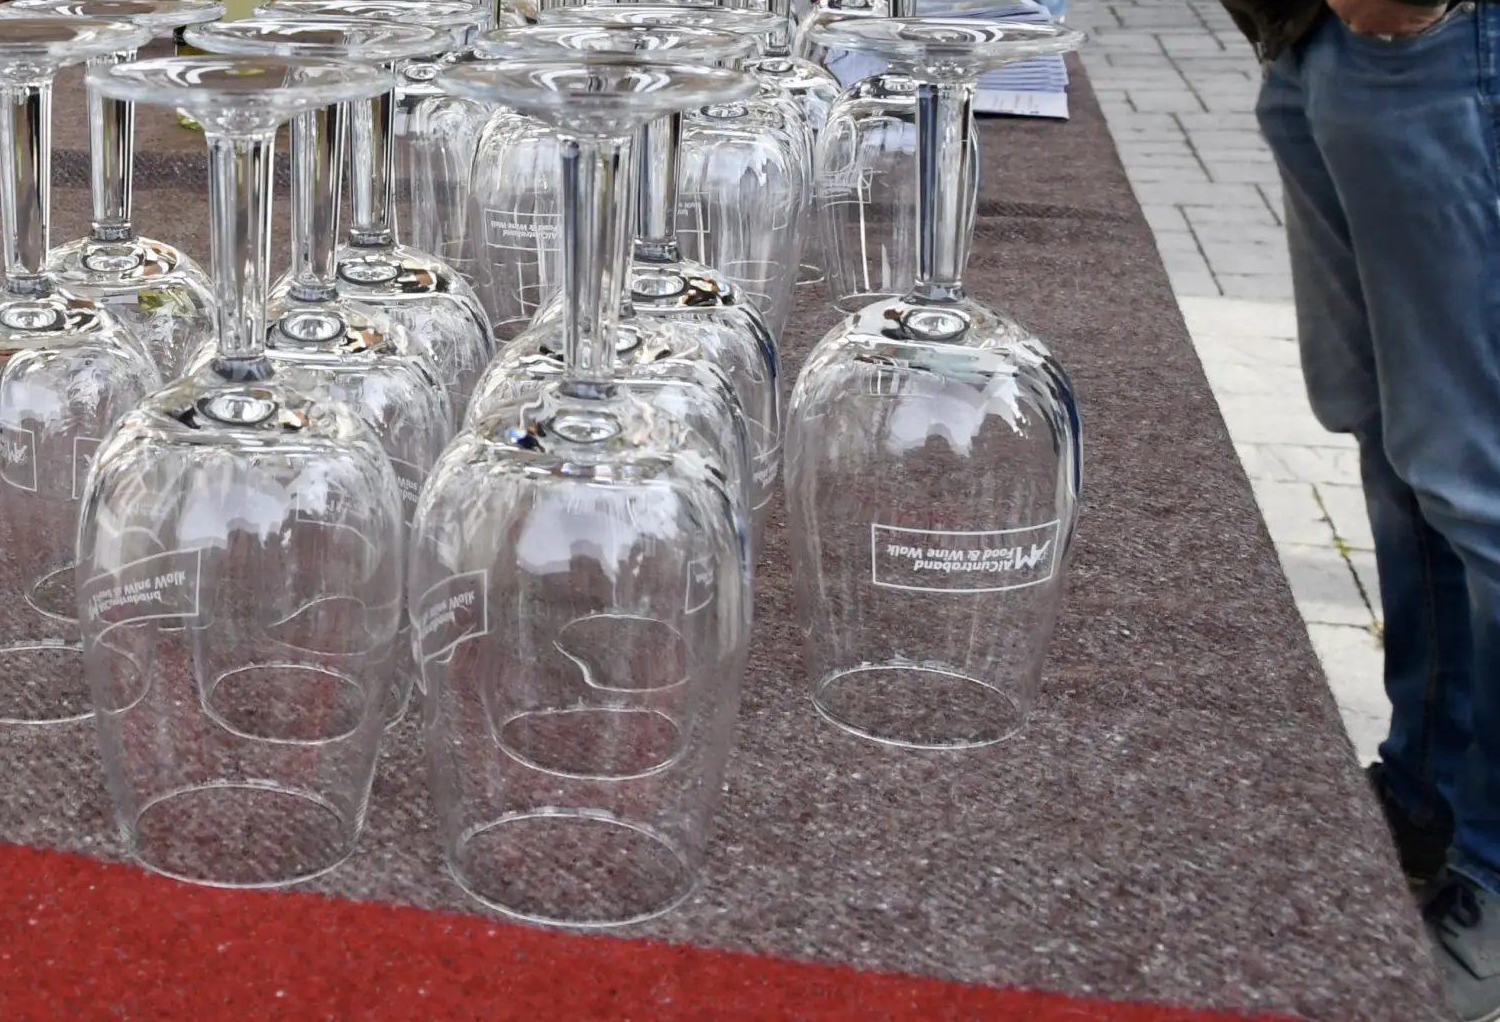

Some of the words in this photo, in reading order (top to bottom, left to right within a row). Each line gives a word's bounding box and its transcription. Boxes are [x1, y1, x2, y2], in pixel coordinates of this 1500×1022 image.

[886, 544, 923, 559] Walk
[927, 548, 964, 561] Wine
[967, 550, 981, 561] &
[983, 547, 1015, 560] Food
[913, 559, 1014, 574] AlCuntraband
